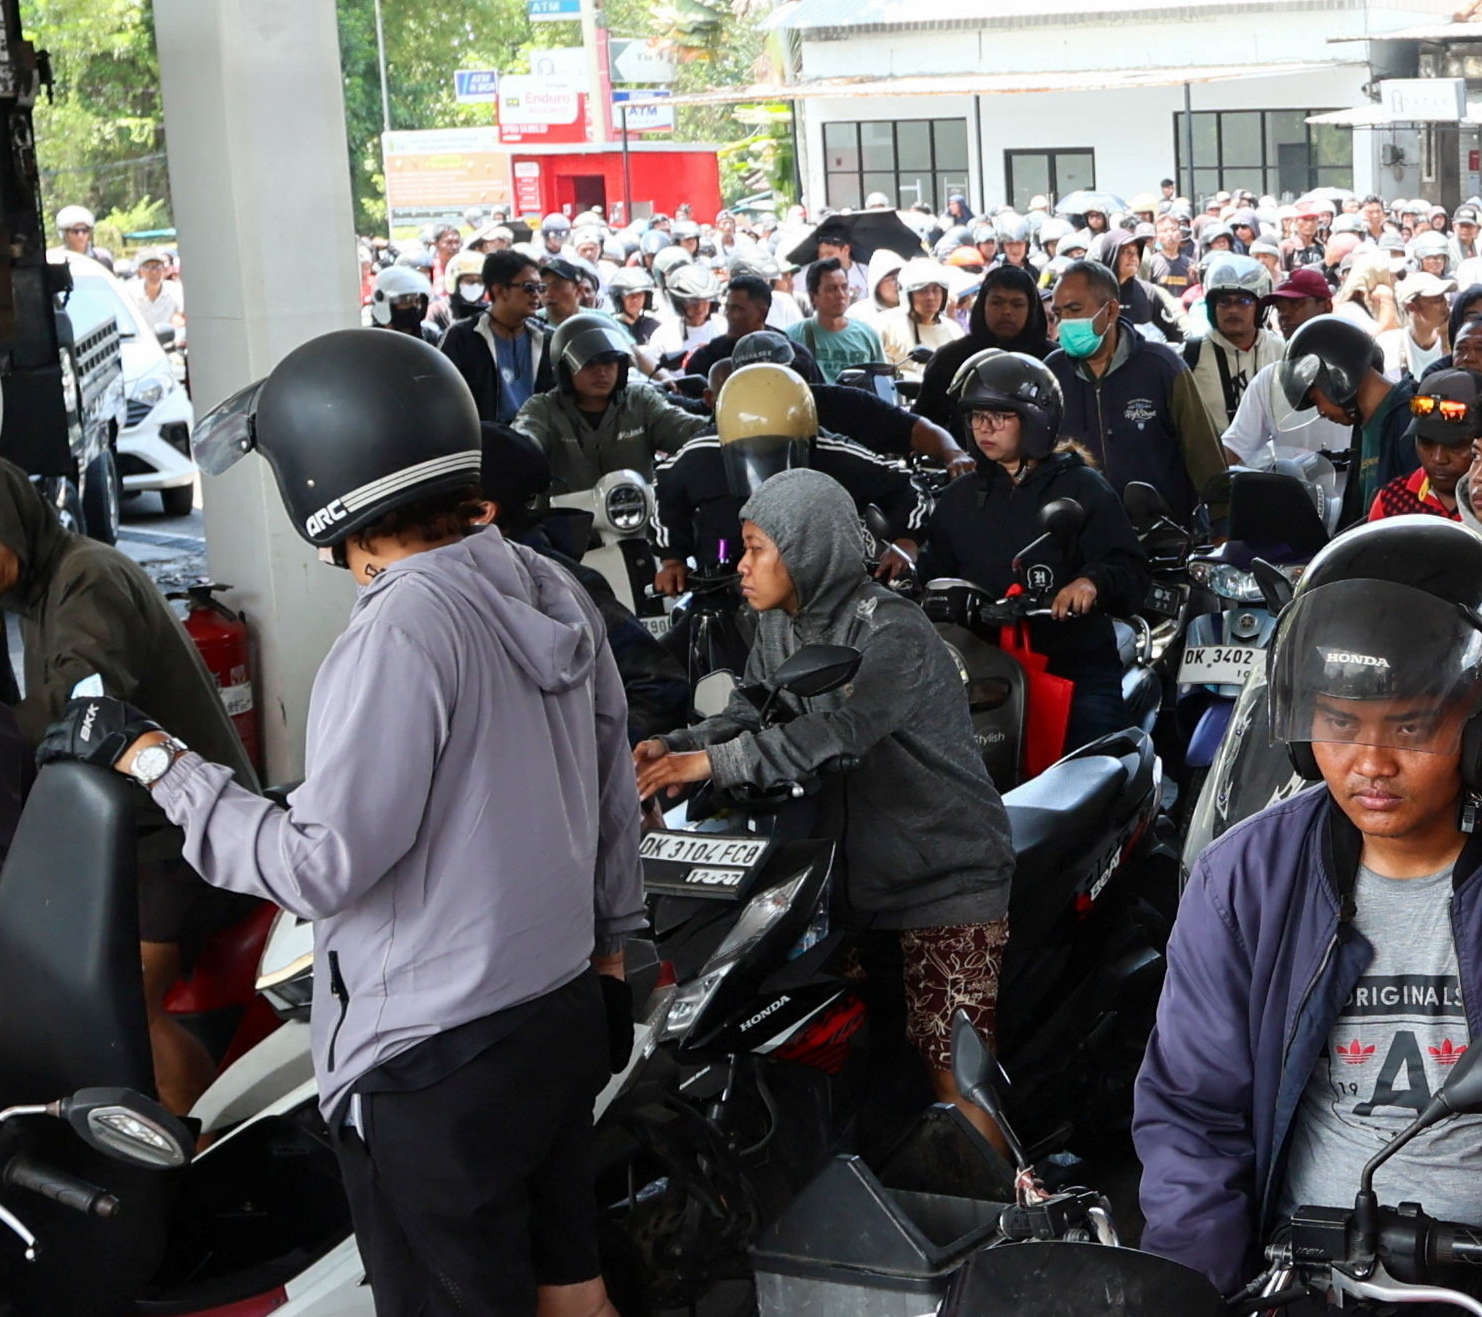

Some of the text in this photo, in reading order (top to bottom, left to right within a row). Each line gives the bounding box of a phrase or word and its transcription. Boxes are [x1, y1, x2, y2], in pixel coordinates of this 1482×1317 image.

[531, 1, 560, 13] ATM
[525, 92, 571, 105] Enduro
[629, 106, 658, 116] ATM
[306, 498, 347, 538] ARC
[1185, 649, 1253, 665] DK 3402
[1326, 653, 1390, 667] HONDA
[80, 703, 99, 742] BKK
[639, 836, 663, 857] DK
[667, 838, 718, 862] 3104
[1344, 985, 1464, 1008] RIGINALS
[739, 995, 791, 1033] HONDA
[1352, 1030, 1432, 1117] A
[1339, 1081, 1358, 1096] 19
